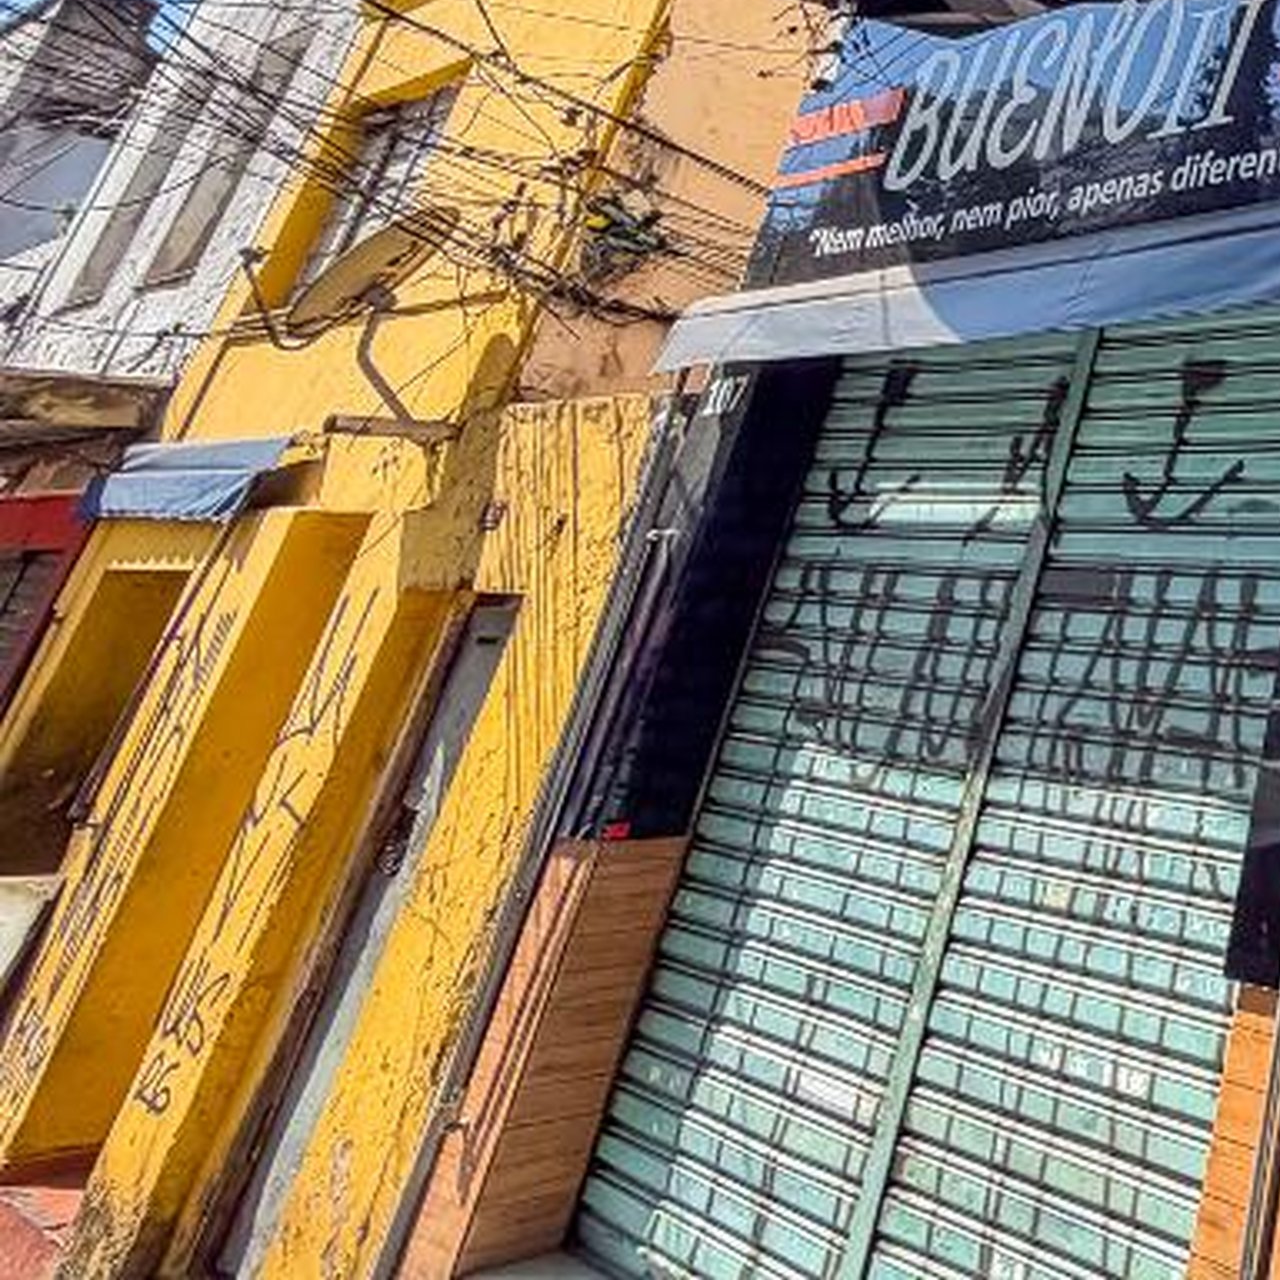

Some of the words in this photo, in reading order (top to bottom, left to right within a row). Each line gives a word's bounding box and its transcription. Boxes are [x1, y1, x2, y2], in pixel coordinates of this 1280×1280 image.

[950, 202, 1003, 233] nem
[1004, 186, 1060, 230] pior,
[1067, 170, 1163, 214] apenas
[703, 373, 750, 415] 107
